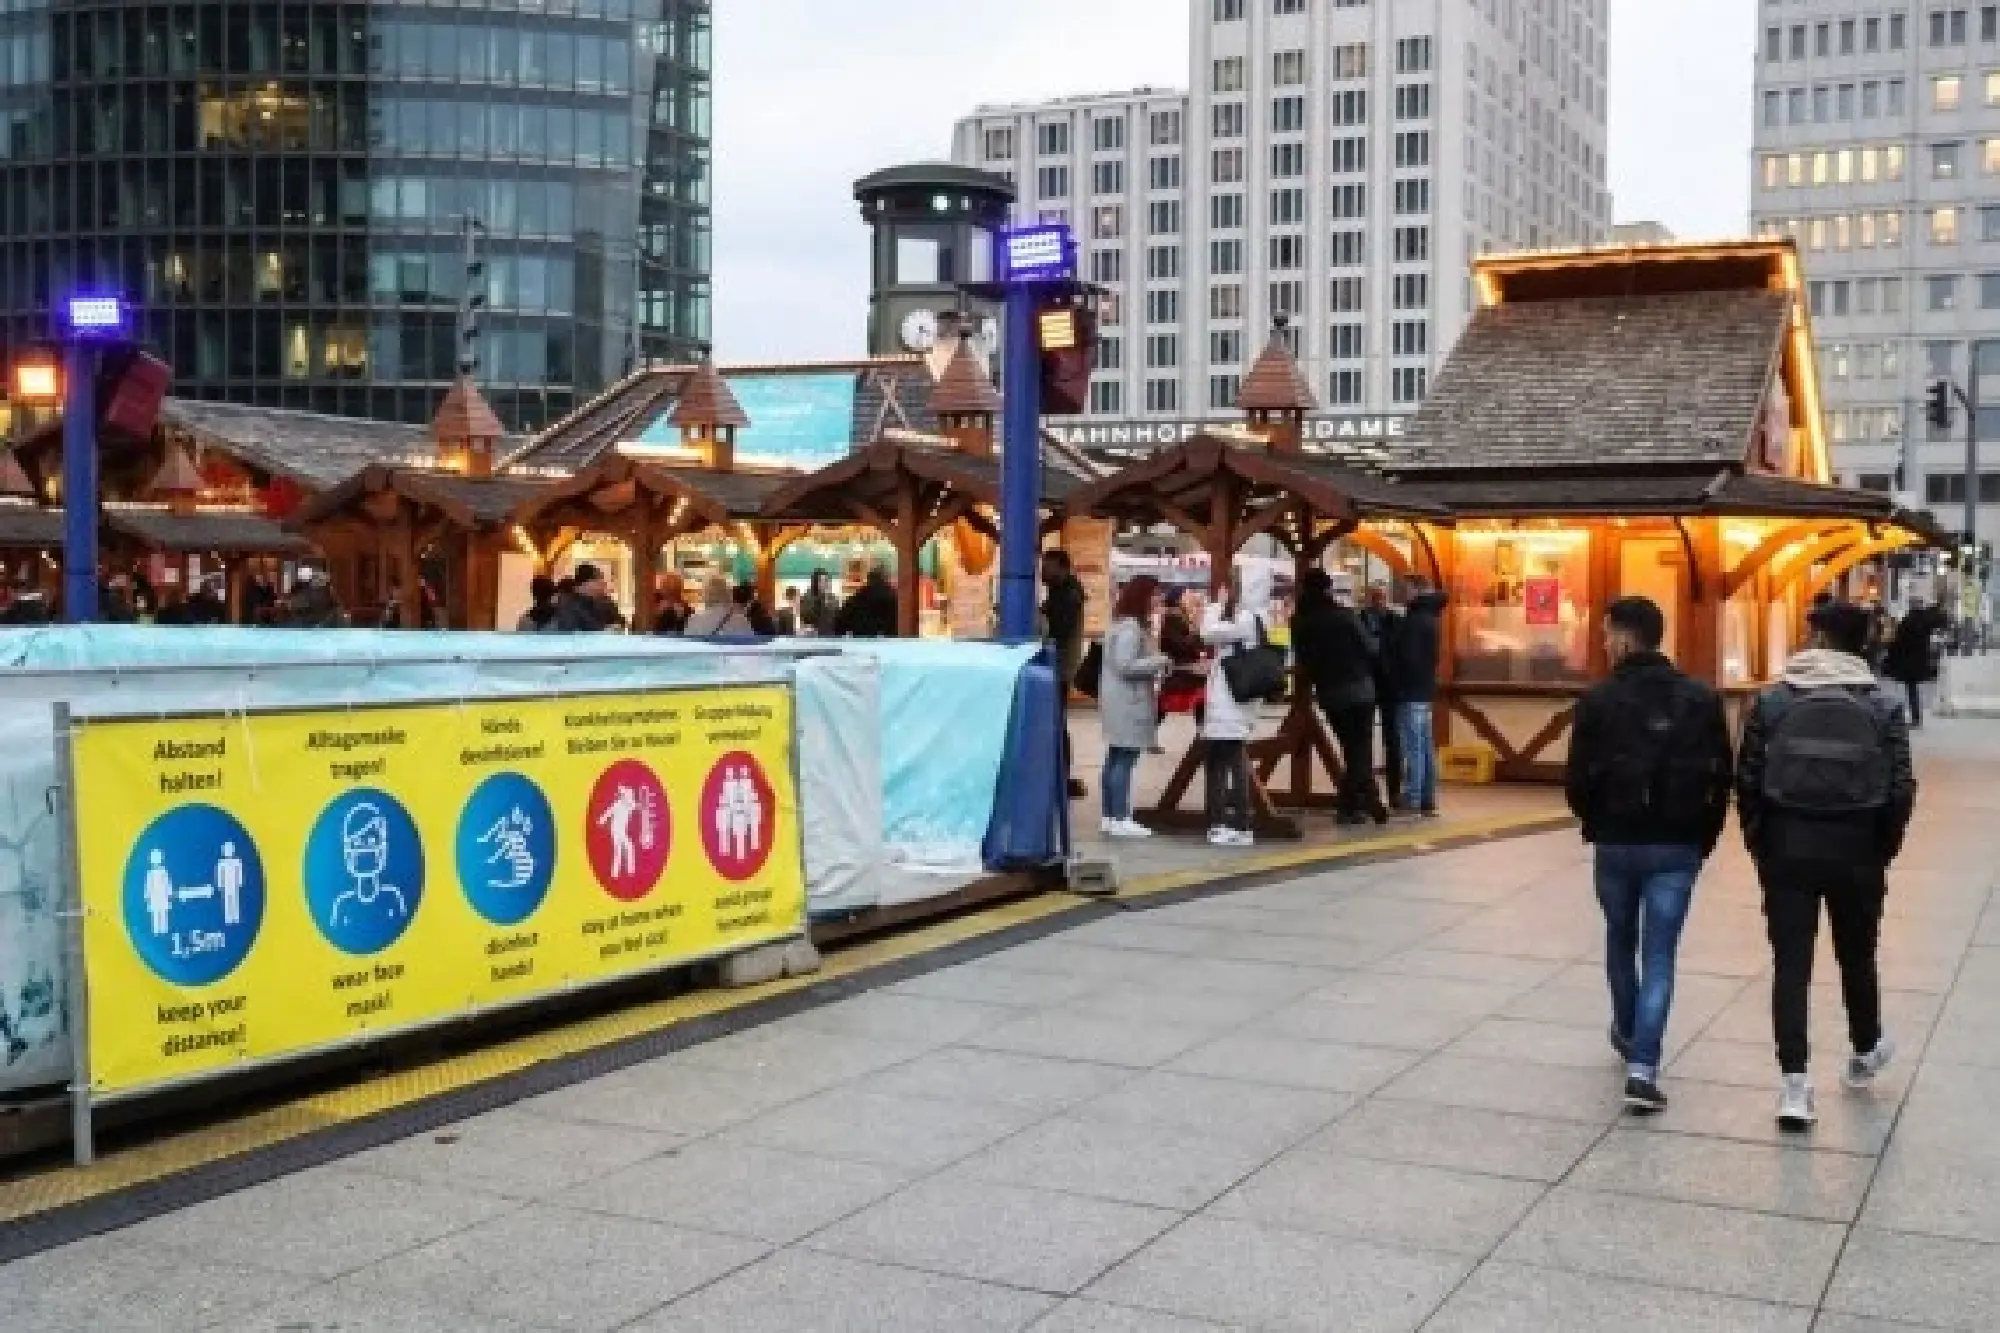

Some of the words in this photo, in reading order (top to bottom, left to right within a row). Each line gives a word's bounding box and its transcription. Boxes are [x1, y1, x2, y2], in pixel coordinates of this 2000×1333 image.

[154, 737, 225, 760] Abstand
[160, 768, 222, 792] halten!
[330, 758, 386, 780] tragen!
[172, 930, 225, 957] 1,5m
[158, 1003, 204, 1024] keep
[207, 996, 246, 1020] your
[161, 1024, 246, 1056] distance!
